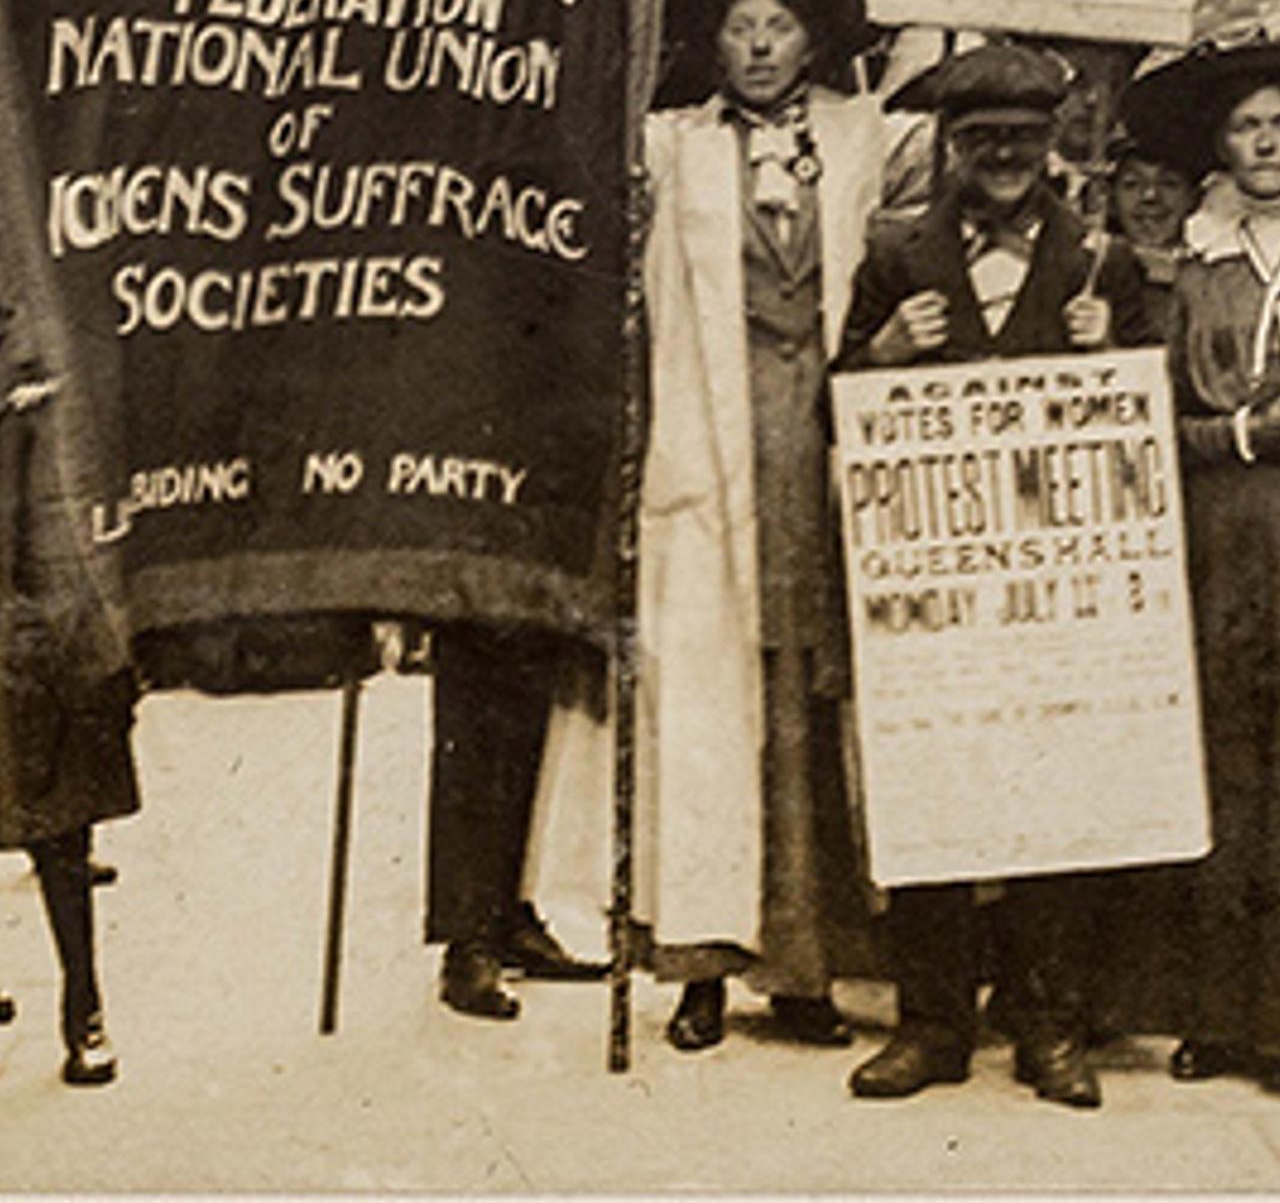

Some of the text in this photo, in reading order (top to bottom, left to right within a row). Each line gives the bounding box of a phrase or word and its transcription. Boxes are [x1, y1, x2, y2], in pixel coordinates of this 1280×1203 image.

[47, 16, 560, 109] NATIONAL UNION
[269, 105, 333, 157] OF
[267, 163, 589, 260] SUFFRAGE
[112, 256, 446, 335] SOCIETIES
[889, 368, 1116, 401] AGAINST
[858, 393, 1151, 444] VOTES FOR WOMEN
[303, 452, 363, 494] NO
[388, 452, 526, 505] PARTY
[849, 436, 1167, 546] PROTEST MEETING
[865, 588, 977, 633] MONDAY
